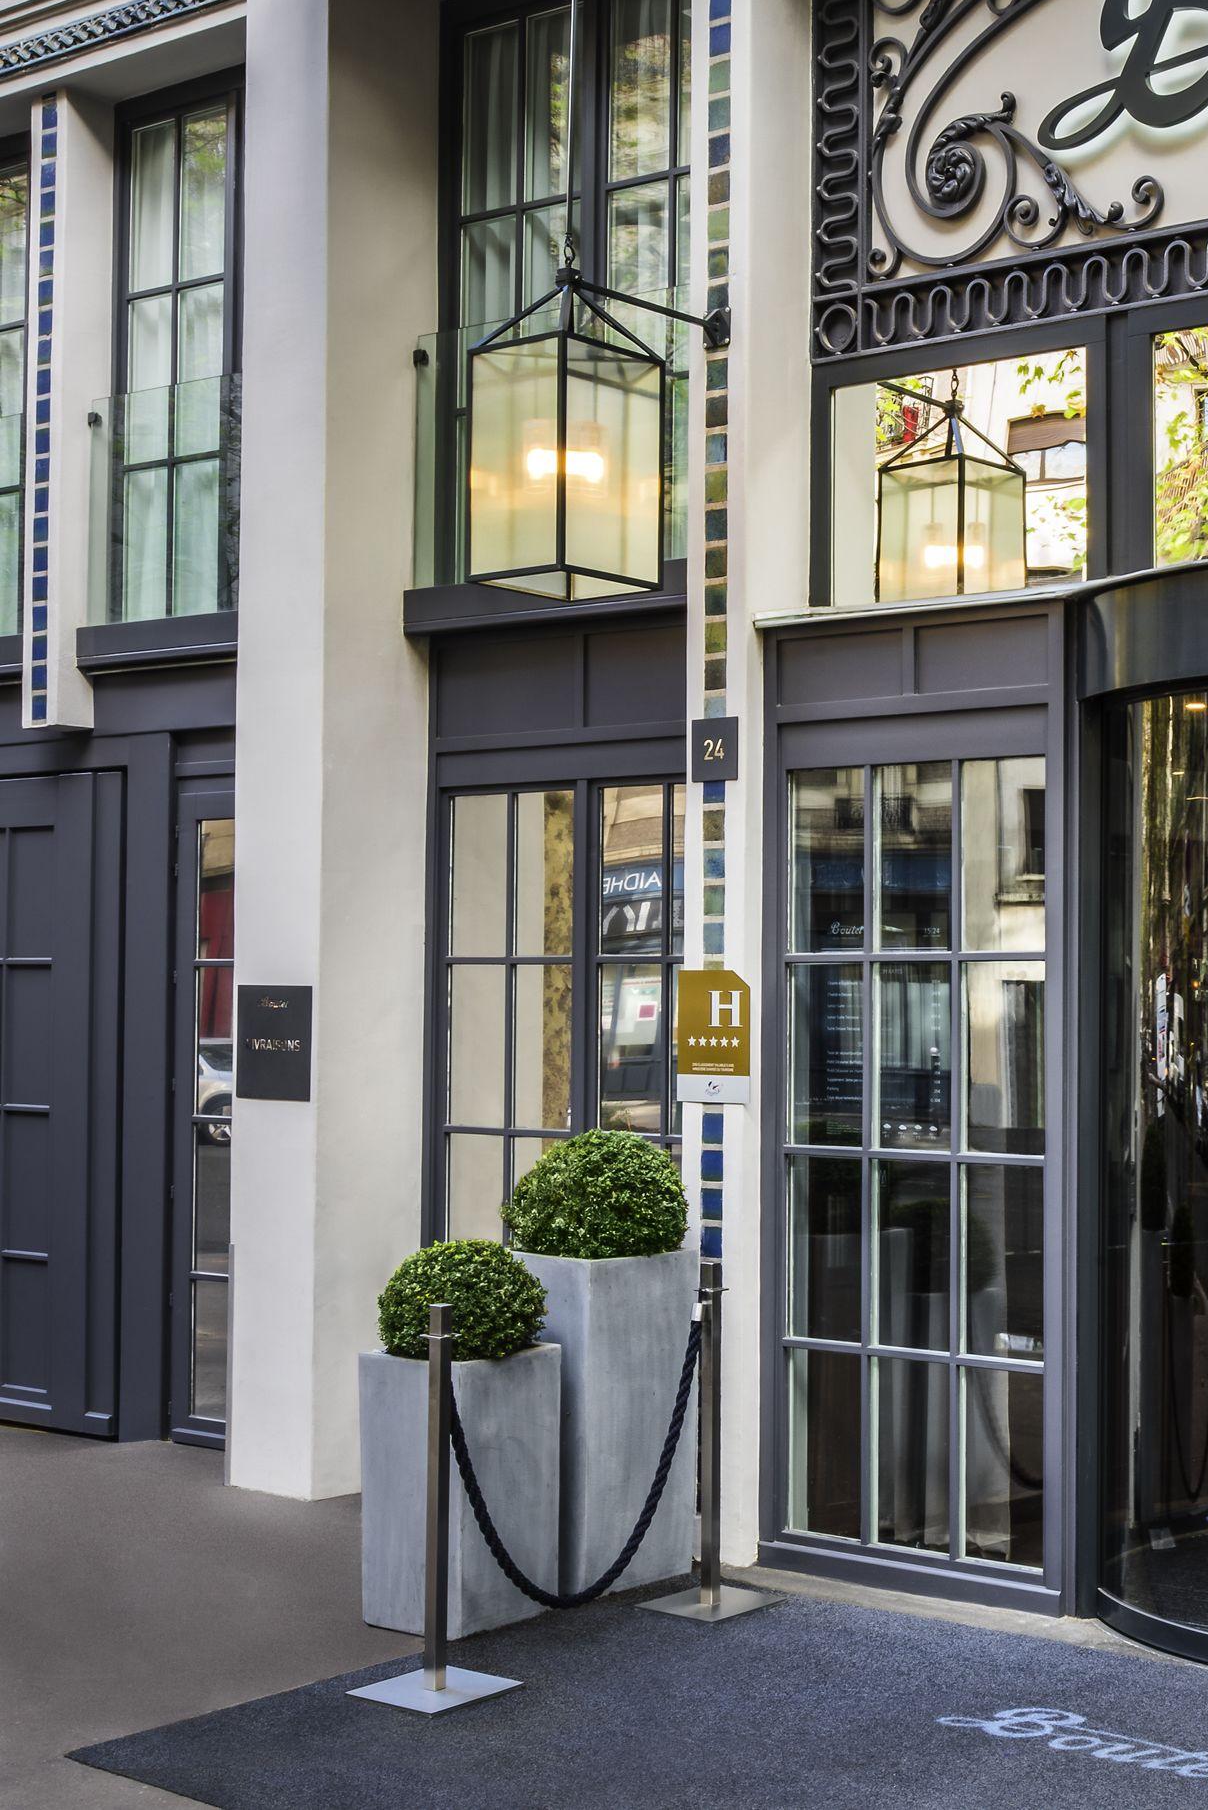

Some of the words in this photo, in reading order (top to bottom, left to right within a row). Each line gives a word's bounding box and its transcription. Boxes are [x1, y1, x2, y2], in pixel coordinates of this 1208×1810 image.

[703, 738, 725, 761] 24
[707, 990, 743, 1028] H
[246, 1037, 301, 1052] IVRAISONS
